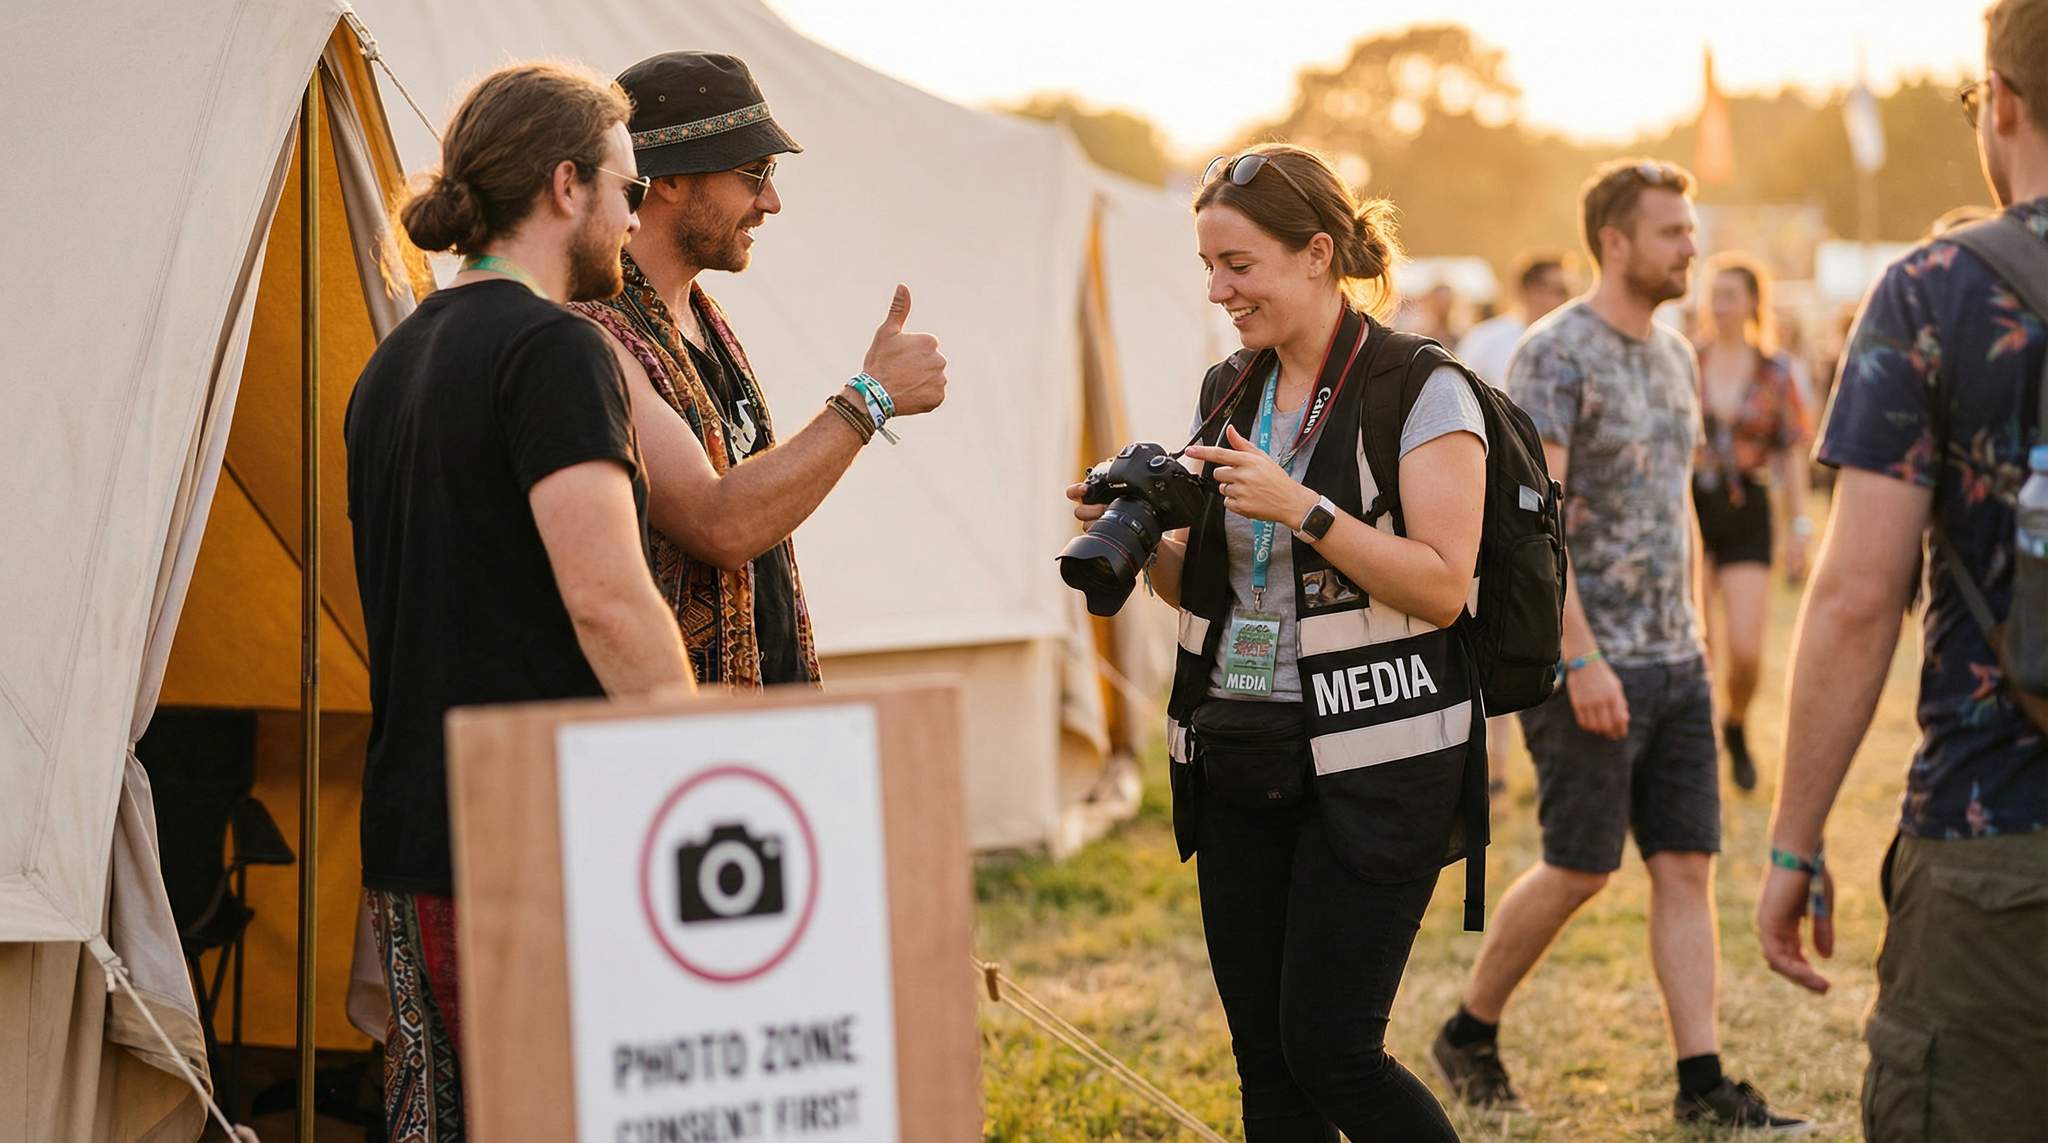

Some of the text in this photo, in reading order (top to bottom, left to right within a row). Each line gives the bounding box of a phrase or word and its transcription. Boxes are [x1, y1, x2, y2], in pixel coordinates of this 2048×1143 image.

[1304, 387, 1331, 433] Canon
[1226, 673, 1266, 690] MEDIA
[1312, 654, 1437, 716] MEDIA
[613, 1015, 856, 1091] PHOTO ZONE
[775, 1087, 860, 1135] FIRST
